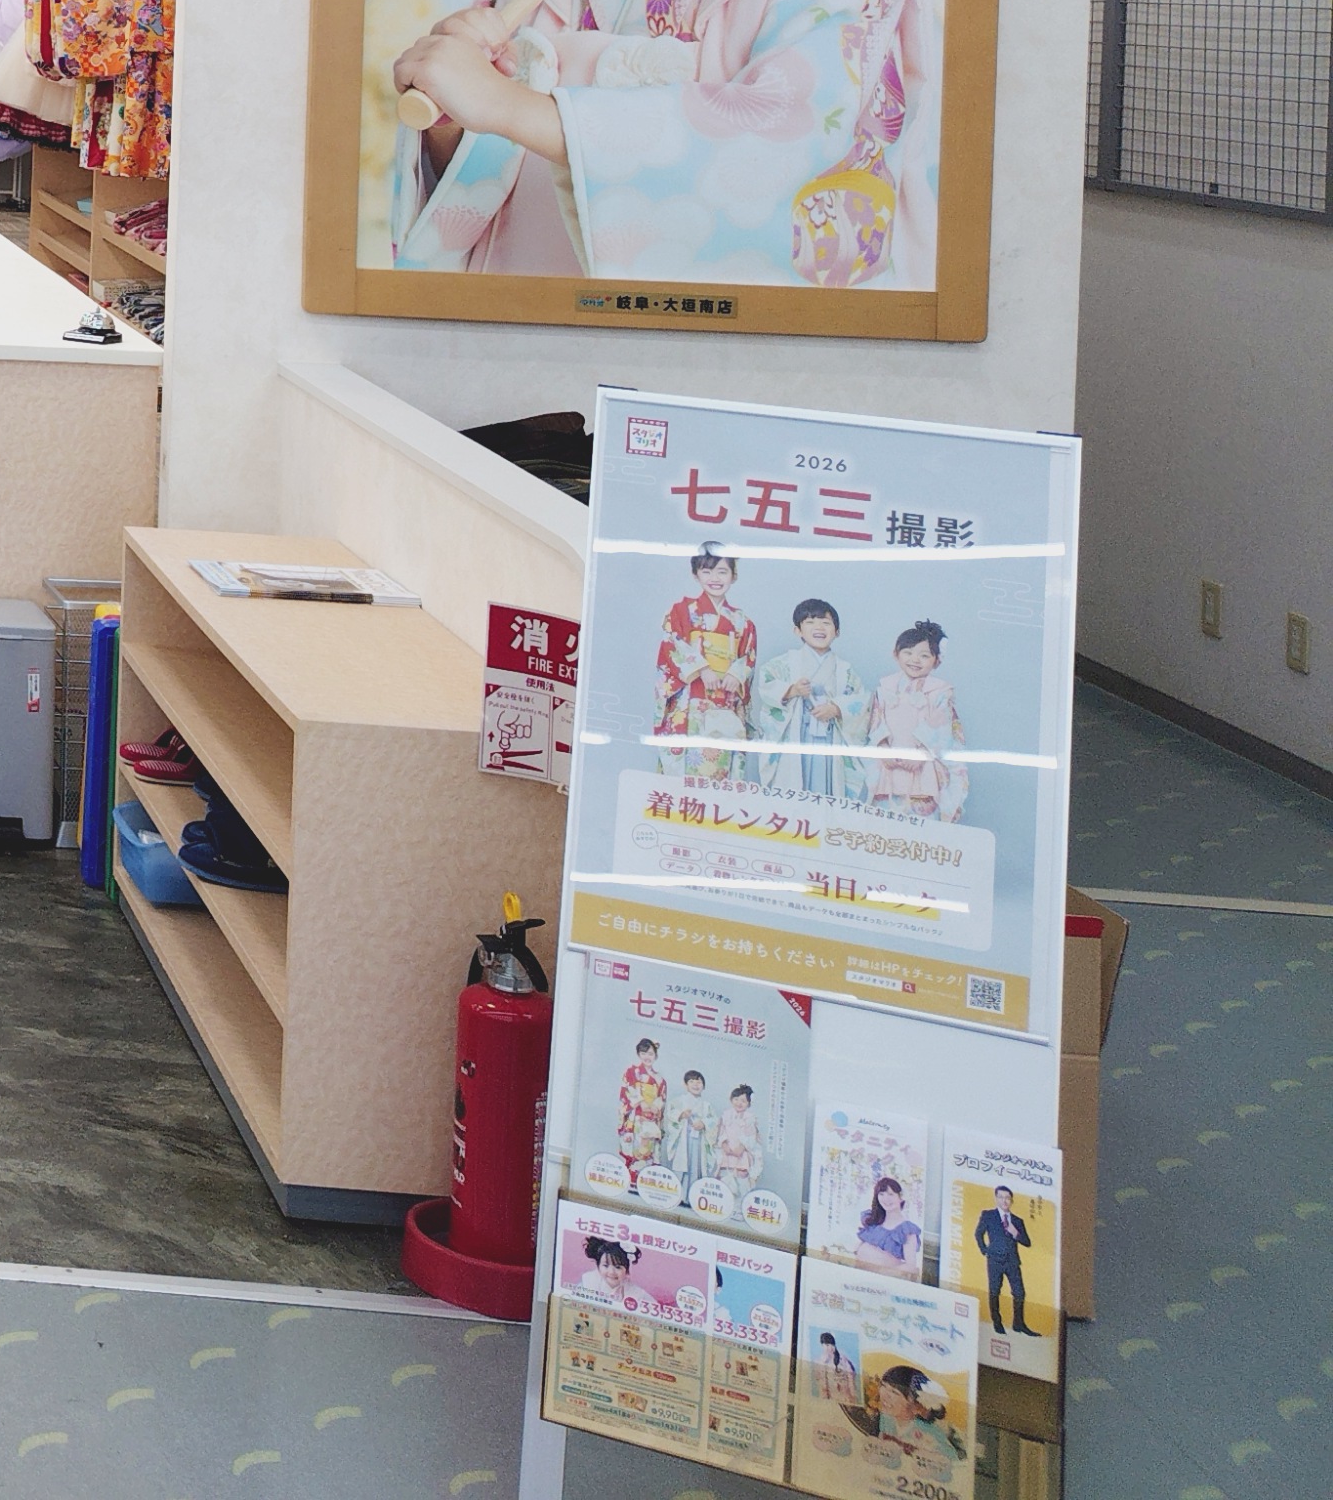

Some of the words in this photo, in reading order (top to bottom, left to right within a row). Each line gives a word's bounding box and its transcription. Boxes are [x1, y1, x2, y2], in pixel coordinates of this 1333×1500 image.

[616, 295, 733, 314] 岐阜・大垣南店
[632, 426, 663, 441] スタジオ
[635, 436, 658, 448] マリオ
[794, 453, 848, 473] 2026
[528, 656, 553, 674] FIRE
[526, 678, 555, 692] 使用法
[646, 789, 821, 841] 着物レンタル
[666, 861, 695, 873] データ
[598, 913, 835, 969] ご自由にチラシをお持ちください
[665, 984, 732, 1005] スタジオマリオの
[629, 990, 767, 1041] 七五三撮影
[788, 996, 806, 1018] 2026
[639, 1300, 704, 1329] 33,333円
